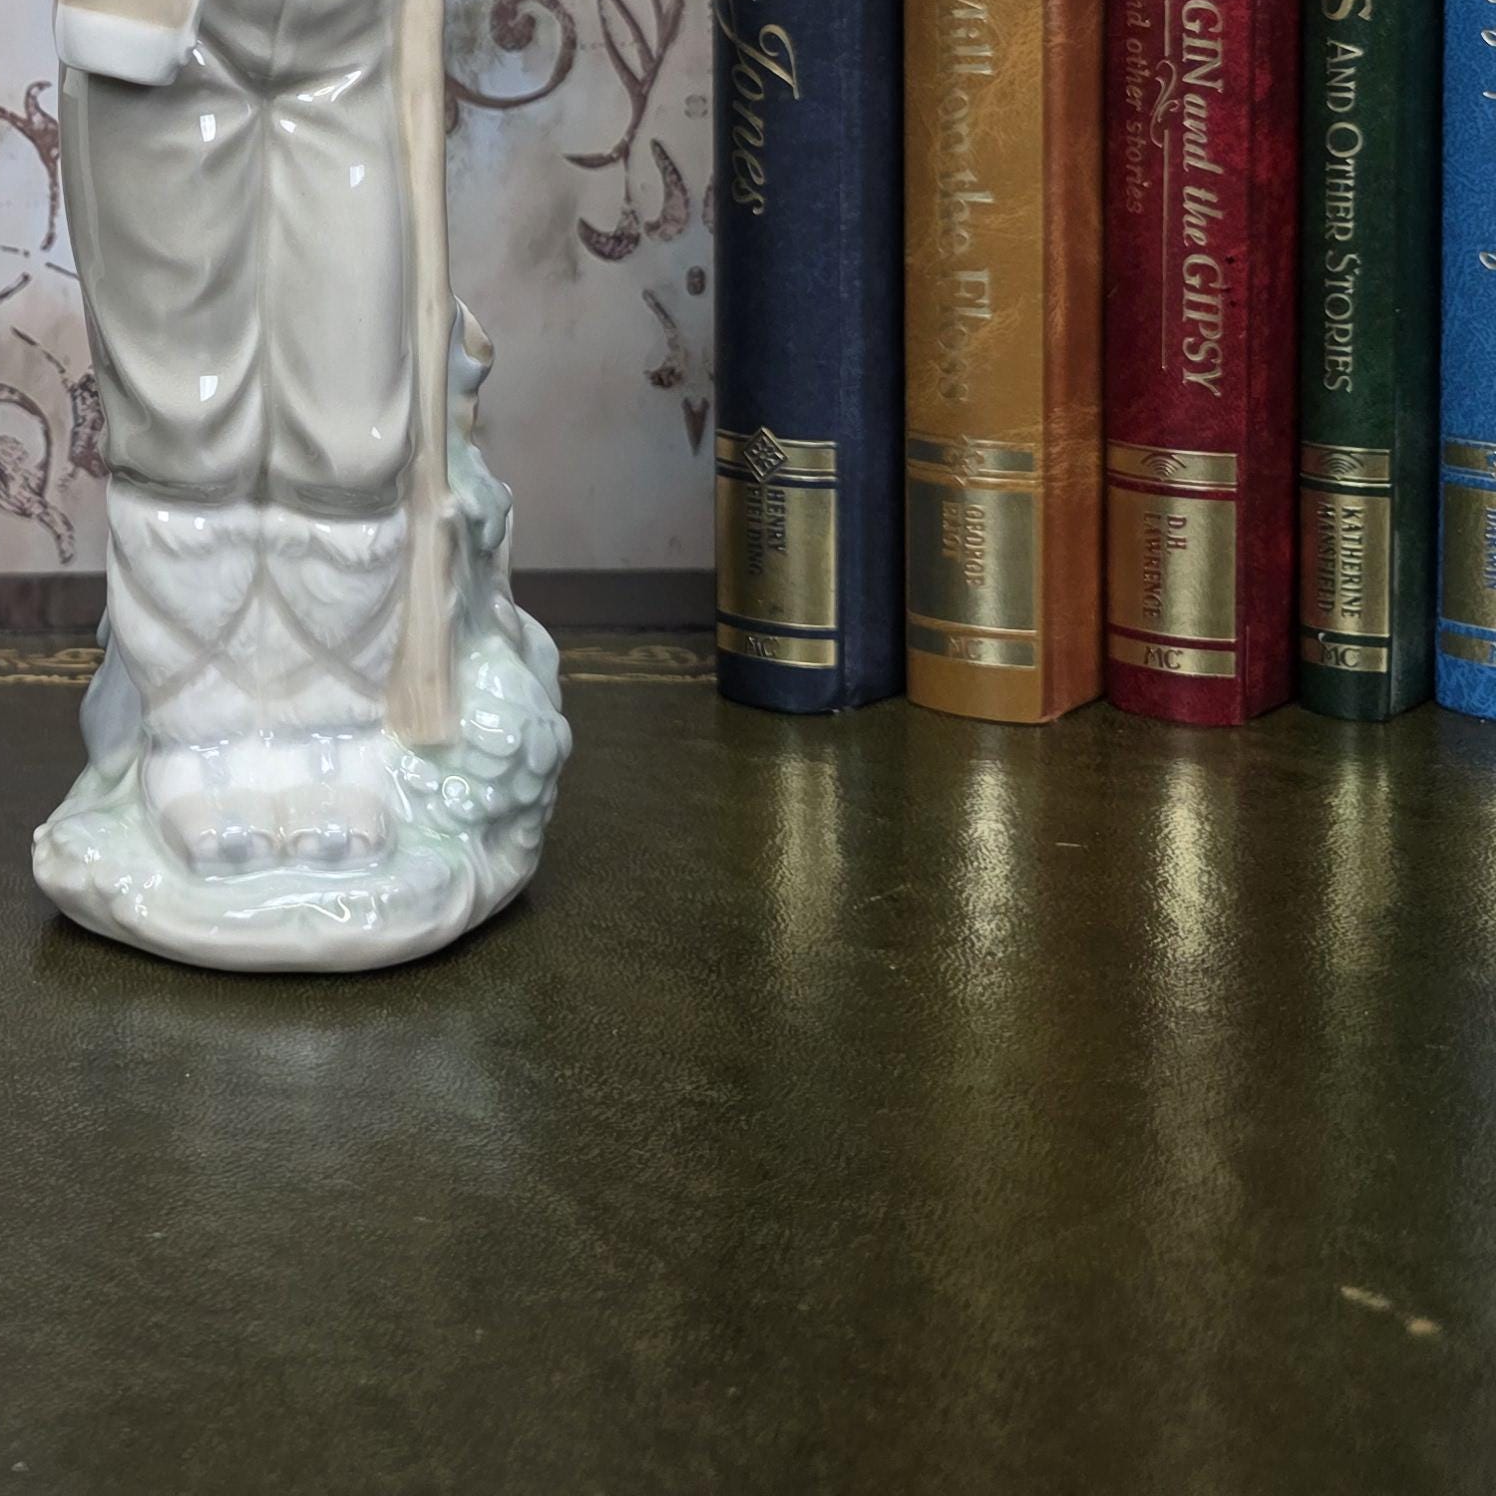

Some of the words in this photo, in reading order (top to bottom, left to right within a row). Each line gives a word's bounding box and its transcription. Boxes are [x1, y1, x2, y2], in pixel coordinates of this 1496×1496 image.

[1125, 38, 1150, 112] other
[937, 88, 972, 152] on
[1182, 95, 1224, 171] and
[1125, 121, 1149, 213] stories
[937, 168, 995, 257] the
[1182, 186, 1223, 247] the
[937, 268, 994, 404] Floss
[1182, 254, 1224, 396] GIPSY
[747, 485, 762, 575] FIELDING
[766, 490, 786, 552] HENRY
[963, 504, 986, 586] GEORGE
[1142, 512, 1162, 619] LAWRENCE
[1166, 515, 1188, 554] D.H.
[1317, 504, 1337, 613] MANSFIELD
[1341, 507, 1364, 619] KATHERINE
